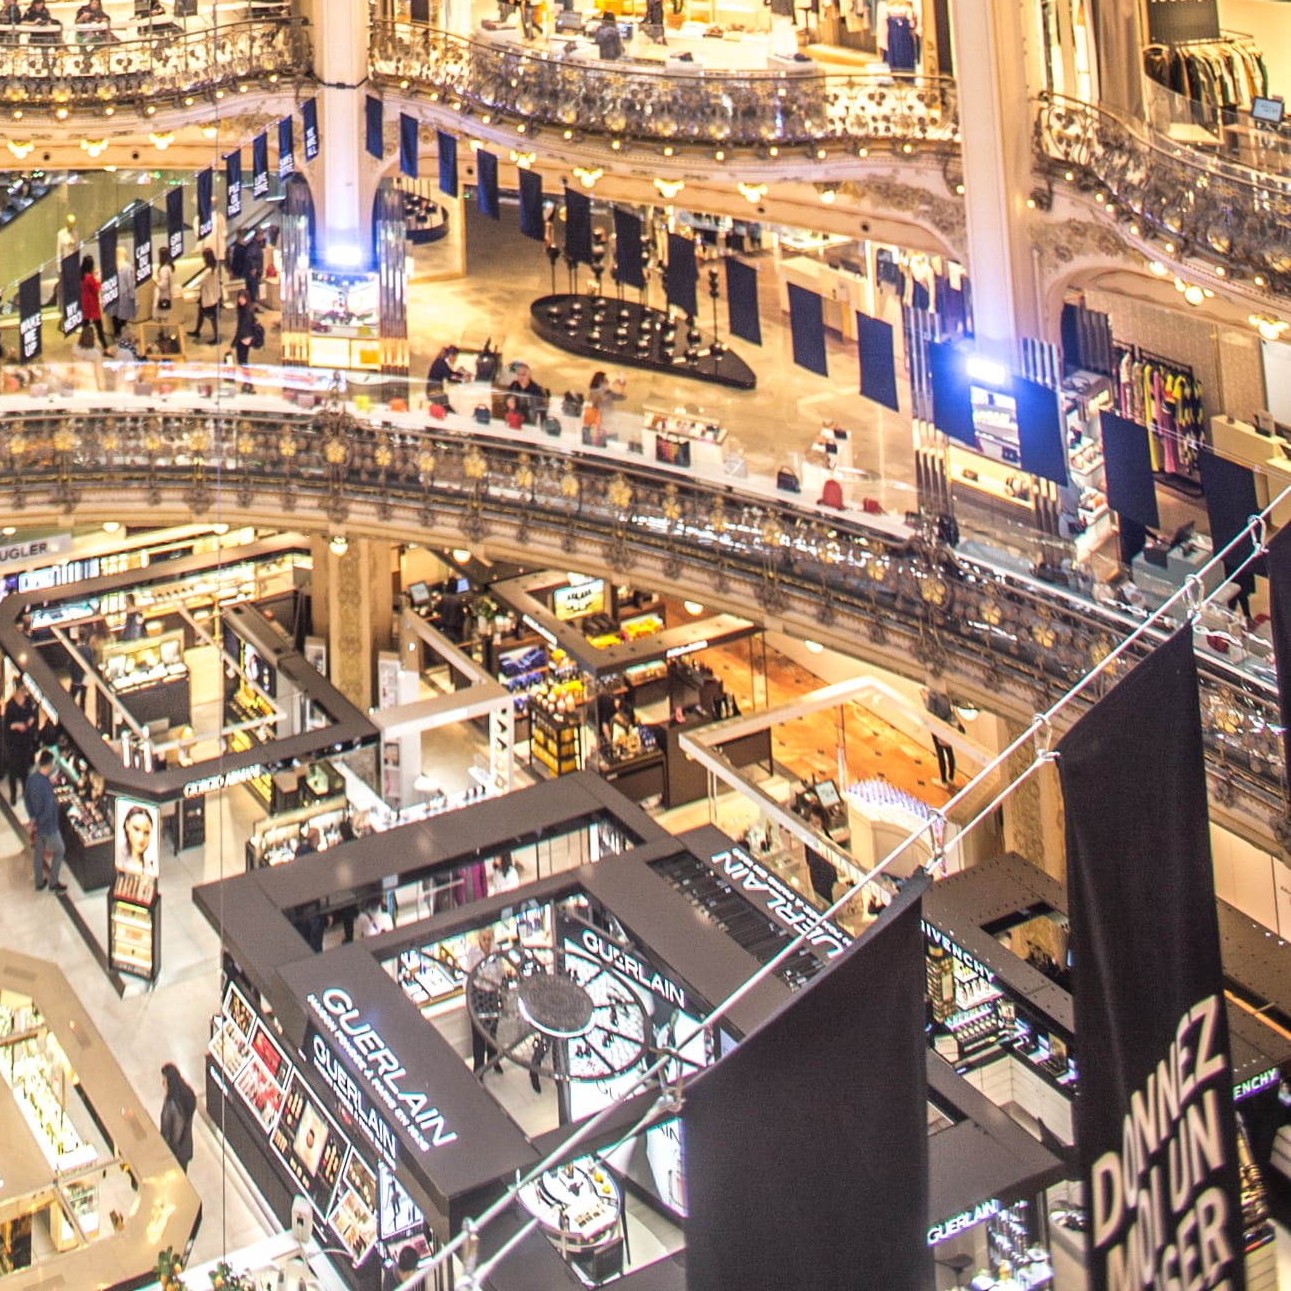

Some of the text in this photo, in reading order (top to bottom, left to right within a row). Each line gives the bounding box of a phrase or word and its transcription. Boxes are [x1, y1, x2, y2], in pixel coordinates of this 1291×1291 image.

[582, 929, 685, 1009] GUERLAIN
[920, 919, 997, 984] IVENCHY
[313, 1034, 398, 1158] GUERLAIN
[322, 986, 458, 1148] GUERLAIN
[1233, 1067, 1279, 1102] ENCHY
[1091, 994, 1228, 1249] DONNEZ
[1168, 1088, 1224, 1214] UN
[927, 1198, 1001, 1247] GUERLAIN
